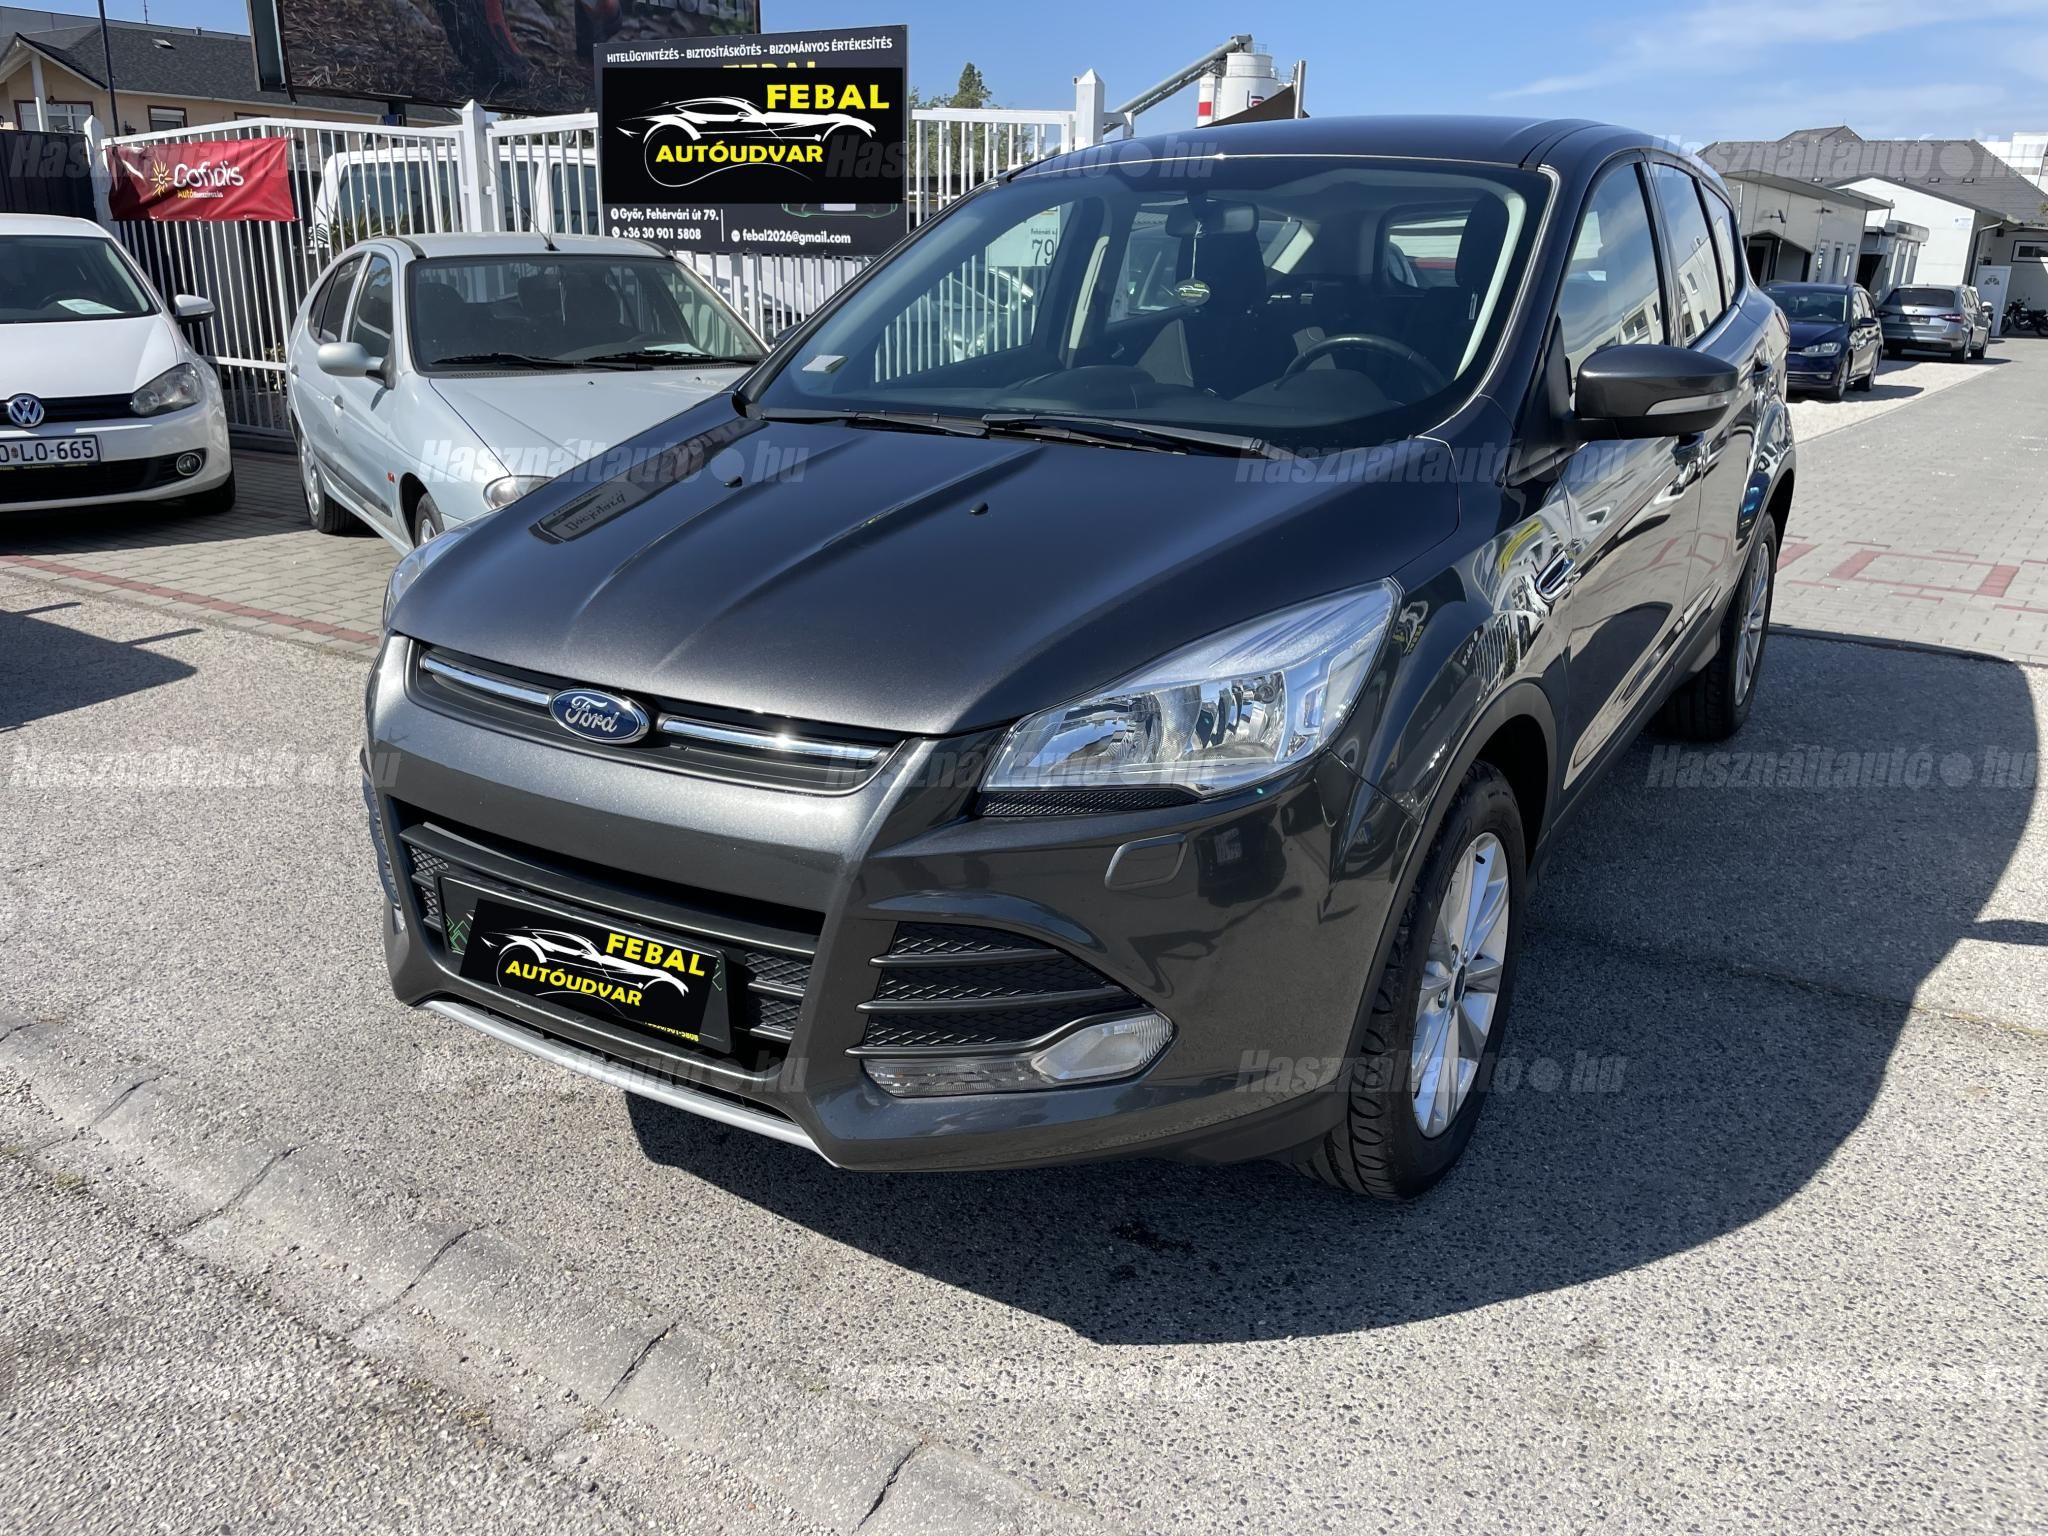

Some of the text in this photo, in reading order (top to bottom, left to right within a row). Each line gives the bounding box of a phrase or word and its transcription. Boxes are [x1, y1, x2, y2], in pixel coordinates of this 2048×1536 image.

[607, 48, 680, 63] HITELÜGYINTÉZÉS
[686, 44, 762, 60] BIZTOSÍTÁSKÖTÉS
[769, 40, 830, 56] BIZOMÁNYOS
[831, 36, 893, 53] ÉRTÉKESÍTÉS
[173, 161, 245, 188] Cofidis
[620, 207, 719, 222] Győr, Fehérvári út 79.
[622, 227, 701, 240] +36 30 901 5808
[742, 229, 851, 245] febal2026@gmail.com
[1032, 238, 1055, 266] 79
[565, 695, 620, 733] Ford
